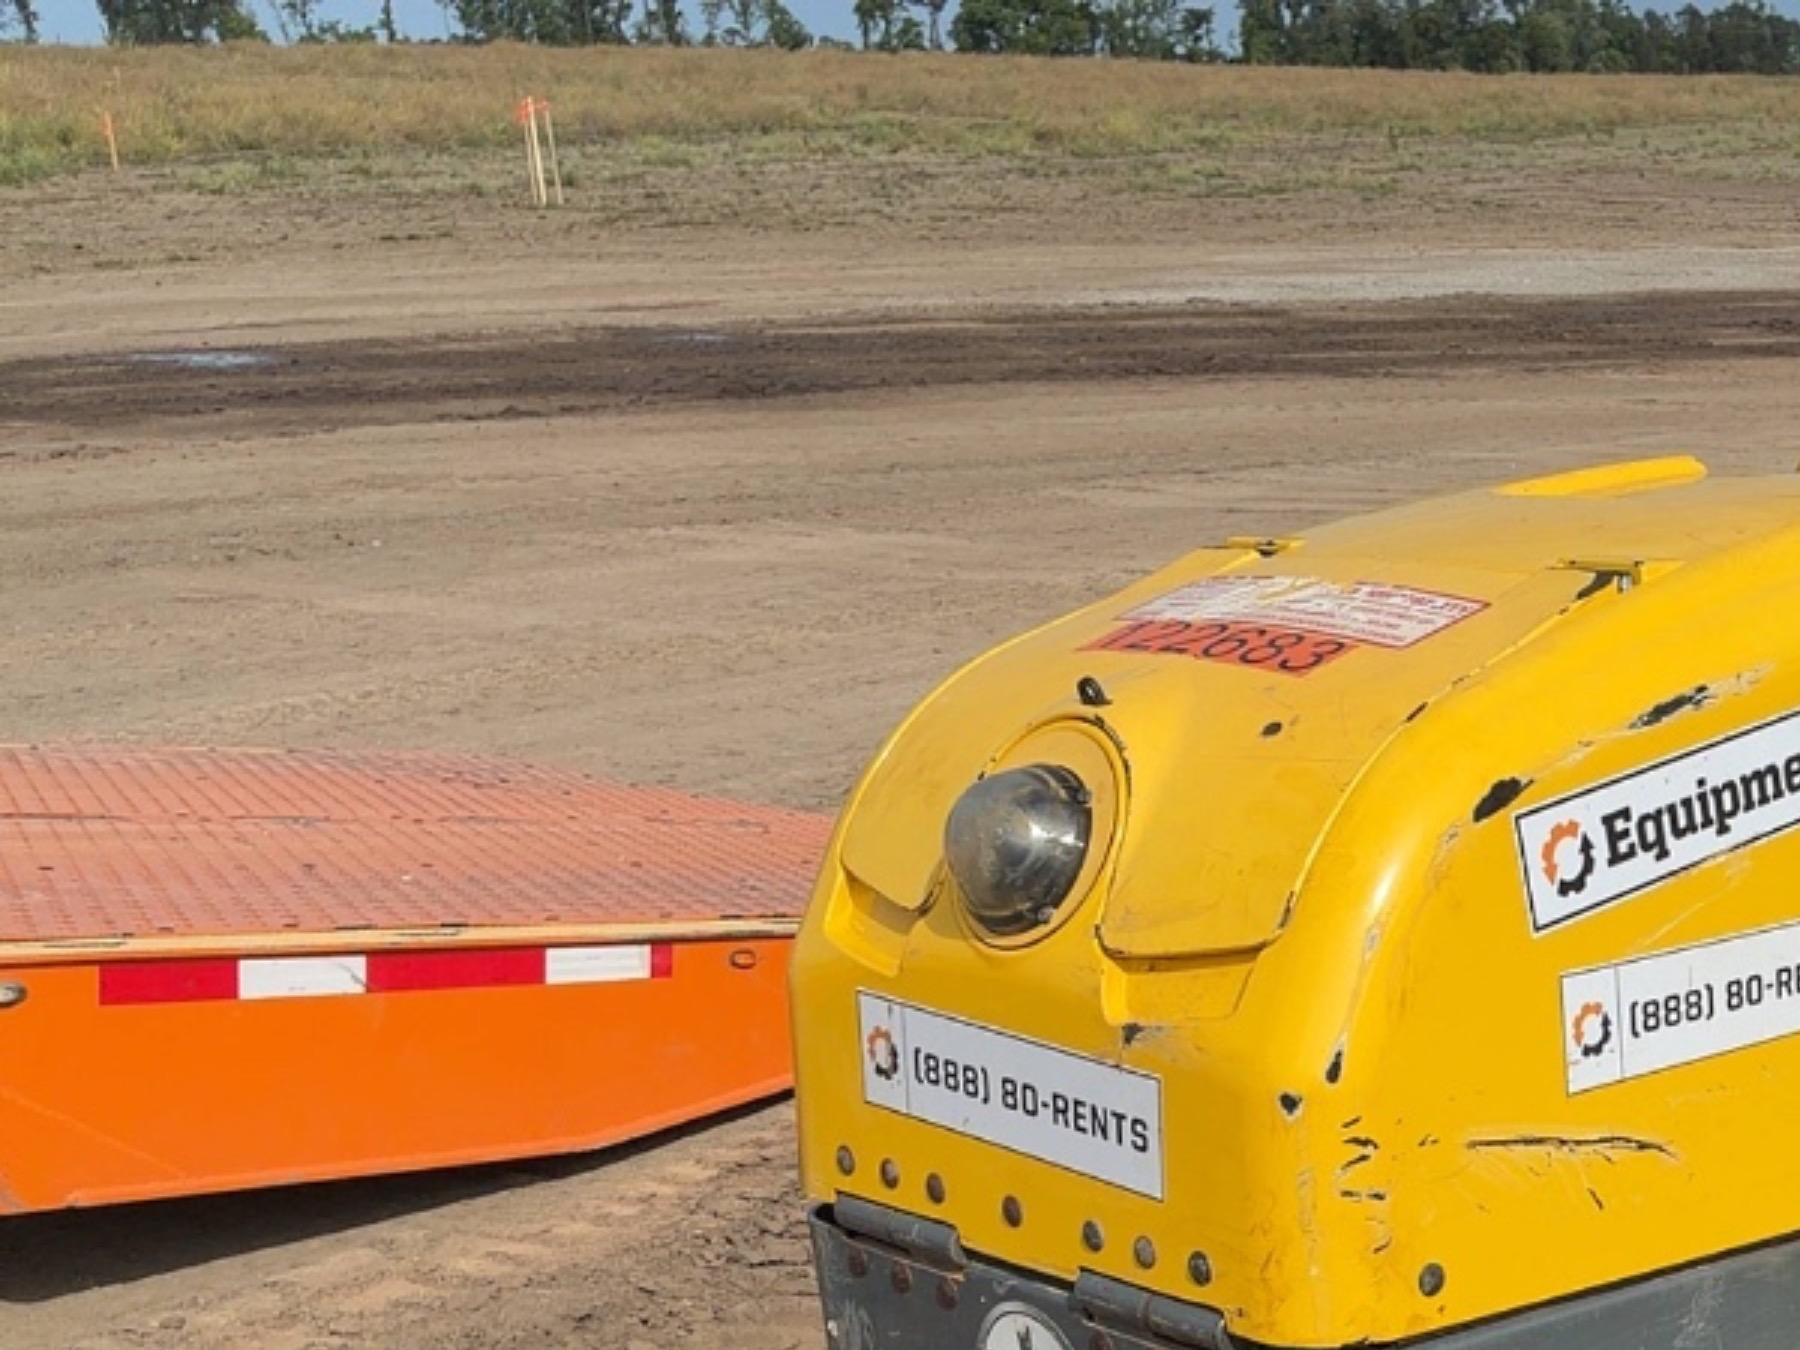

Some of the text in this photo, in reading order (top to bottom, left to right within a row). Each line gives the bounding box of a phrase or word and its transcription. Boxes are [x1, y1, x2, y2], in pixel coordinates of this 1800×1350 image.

[1100, 617, 1346, 672] 122683
[1628, 983, 1715, 1039] (888)
[913, 1046, 1150, 1154] (888) 80-RENTS
